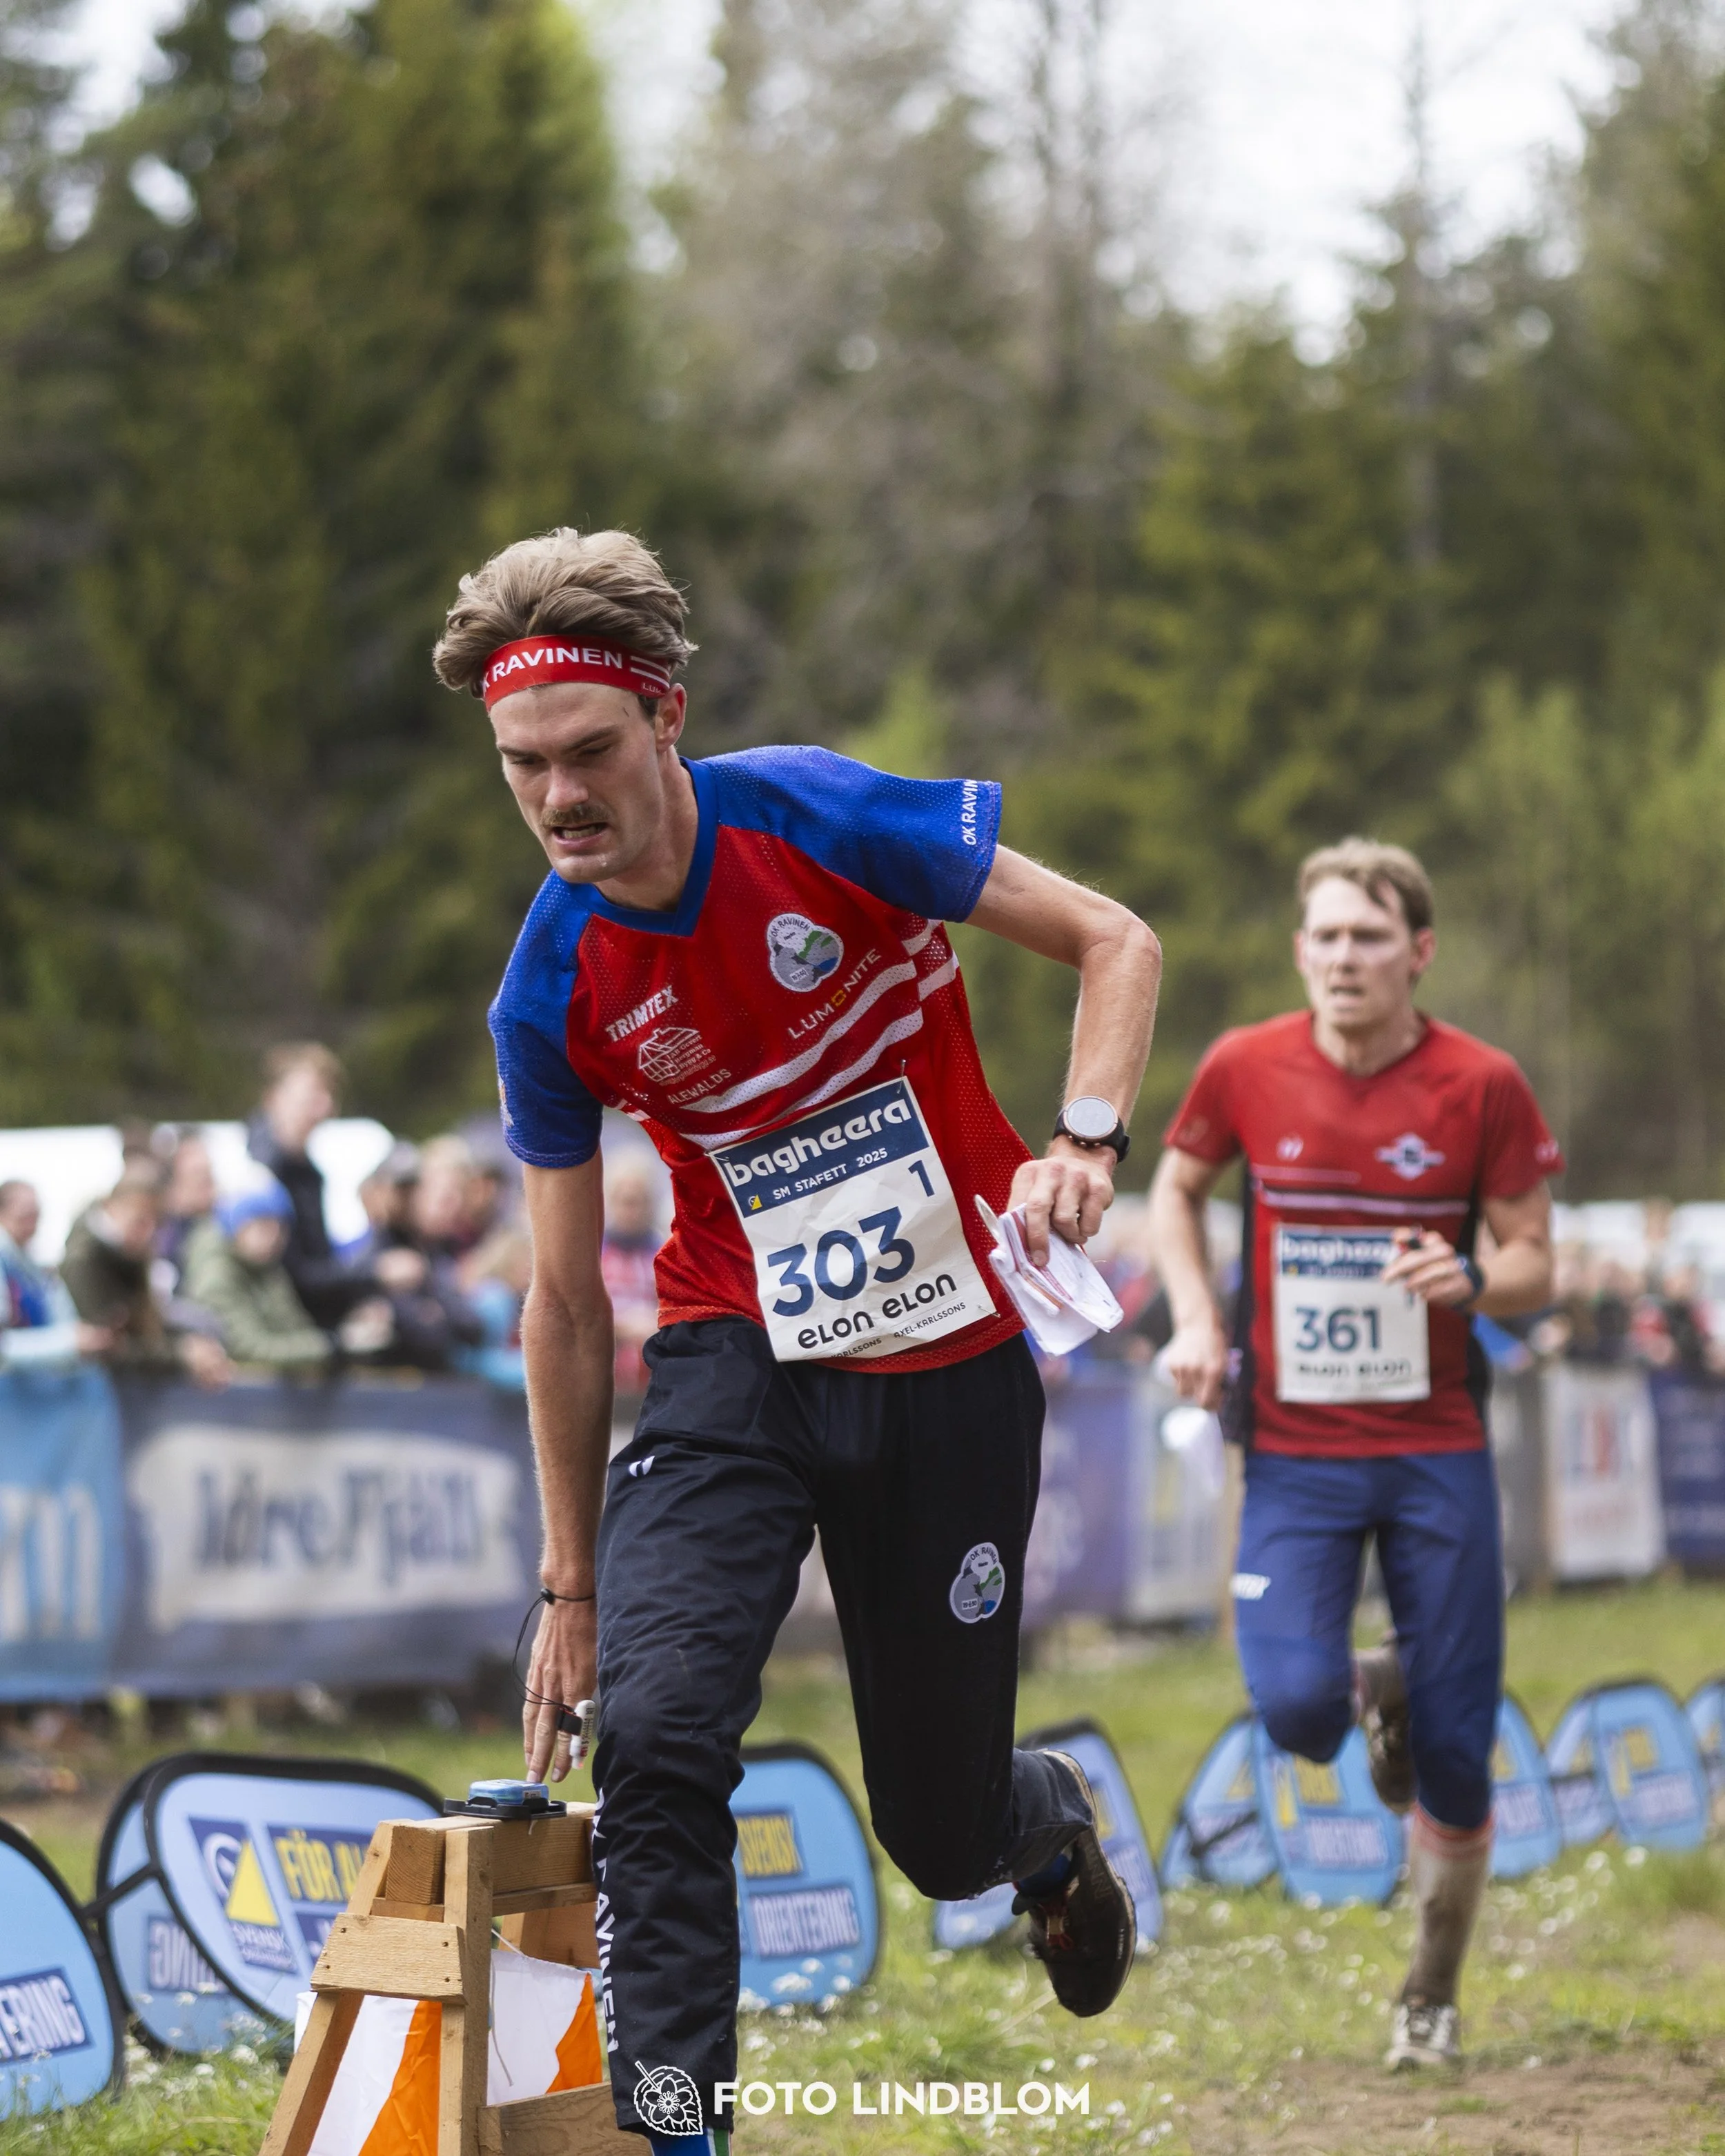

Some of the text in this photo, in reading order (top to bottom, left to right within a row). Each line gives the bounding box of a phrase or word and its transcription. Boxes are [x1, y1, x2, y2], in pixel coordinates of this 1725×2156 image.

[492, 647, 622, 682] RAVINEN
[961, 826, 977, 846] OK
[777, 916, 811, 931] RAVINEN
[605, 985, 679, 1042] TRIMTEX
[788, 948, 882, 1039] LUMONITE
[667, 1069, 731, 1105] ALEWALDS
[723, 1098, 912, 1187] bagheera
[773, 1147, 888, 1200] SM STAFETT 2025
[908, 1159, 934, 1197] 1
[767, 1206, 915, 1318] 303
[831, 1302, 966, 1358] KARLSSONS AXEL-KARLSSONS
[1294, 1306, 1380, 1354] 361
[969, 1550, 980, 1561] OK
[275, 1828, 344, 1901] FÖR
